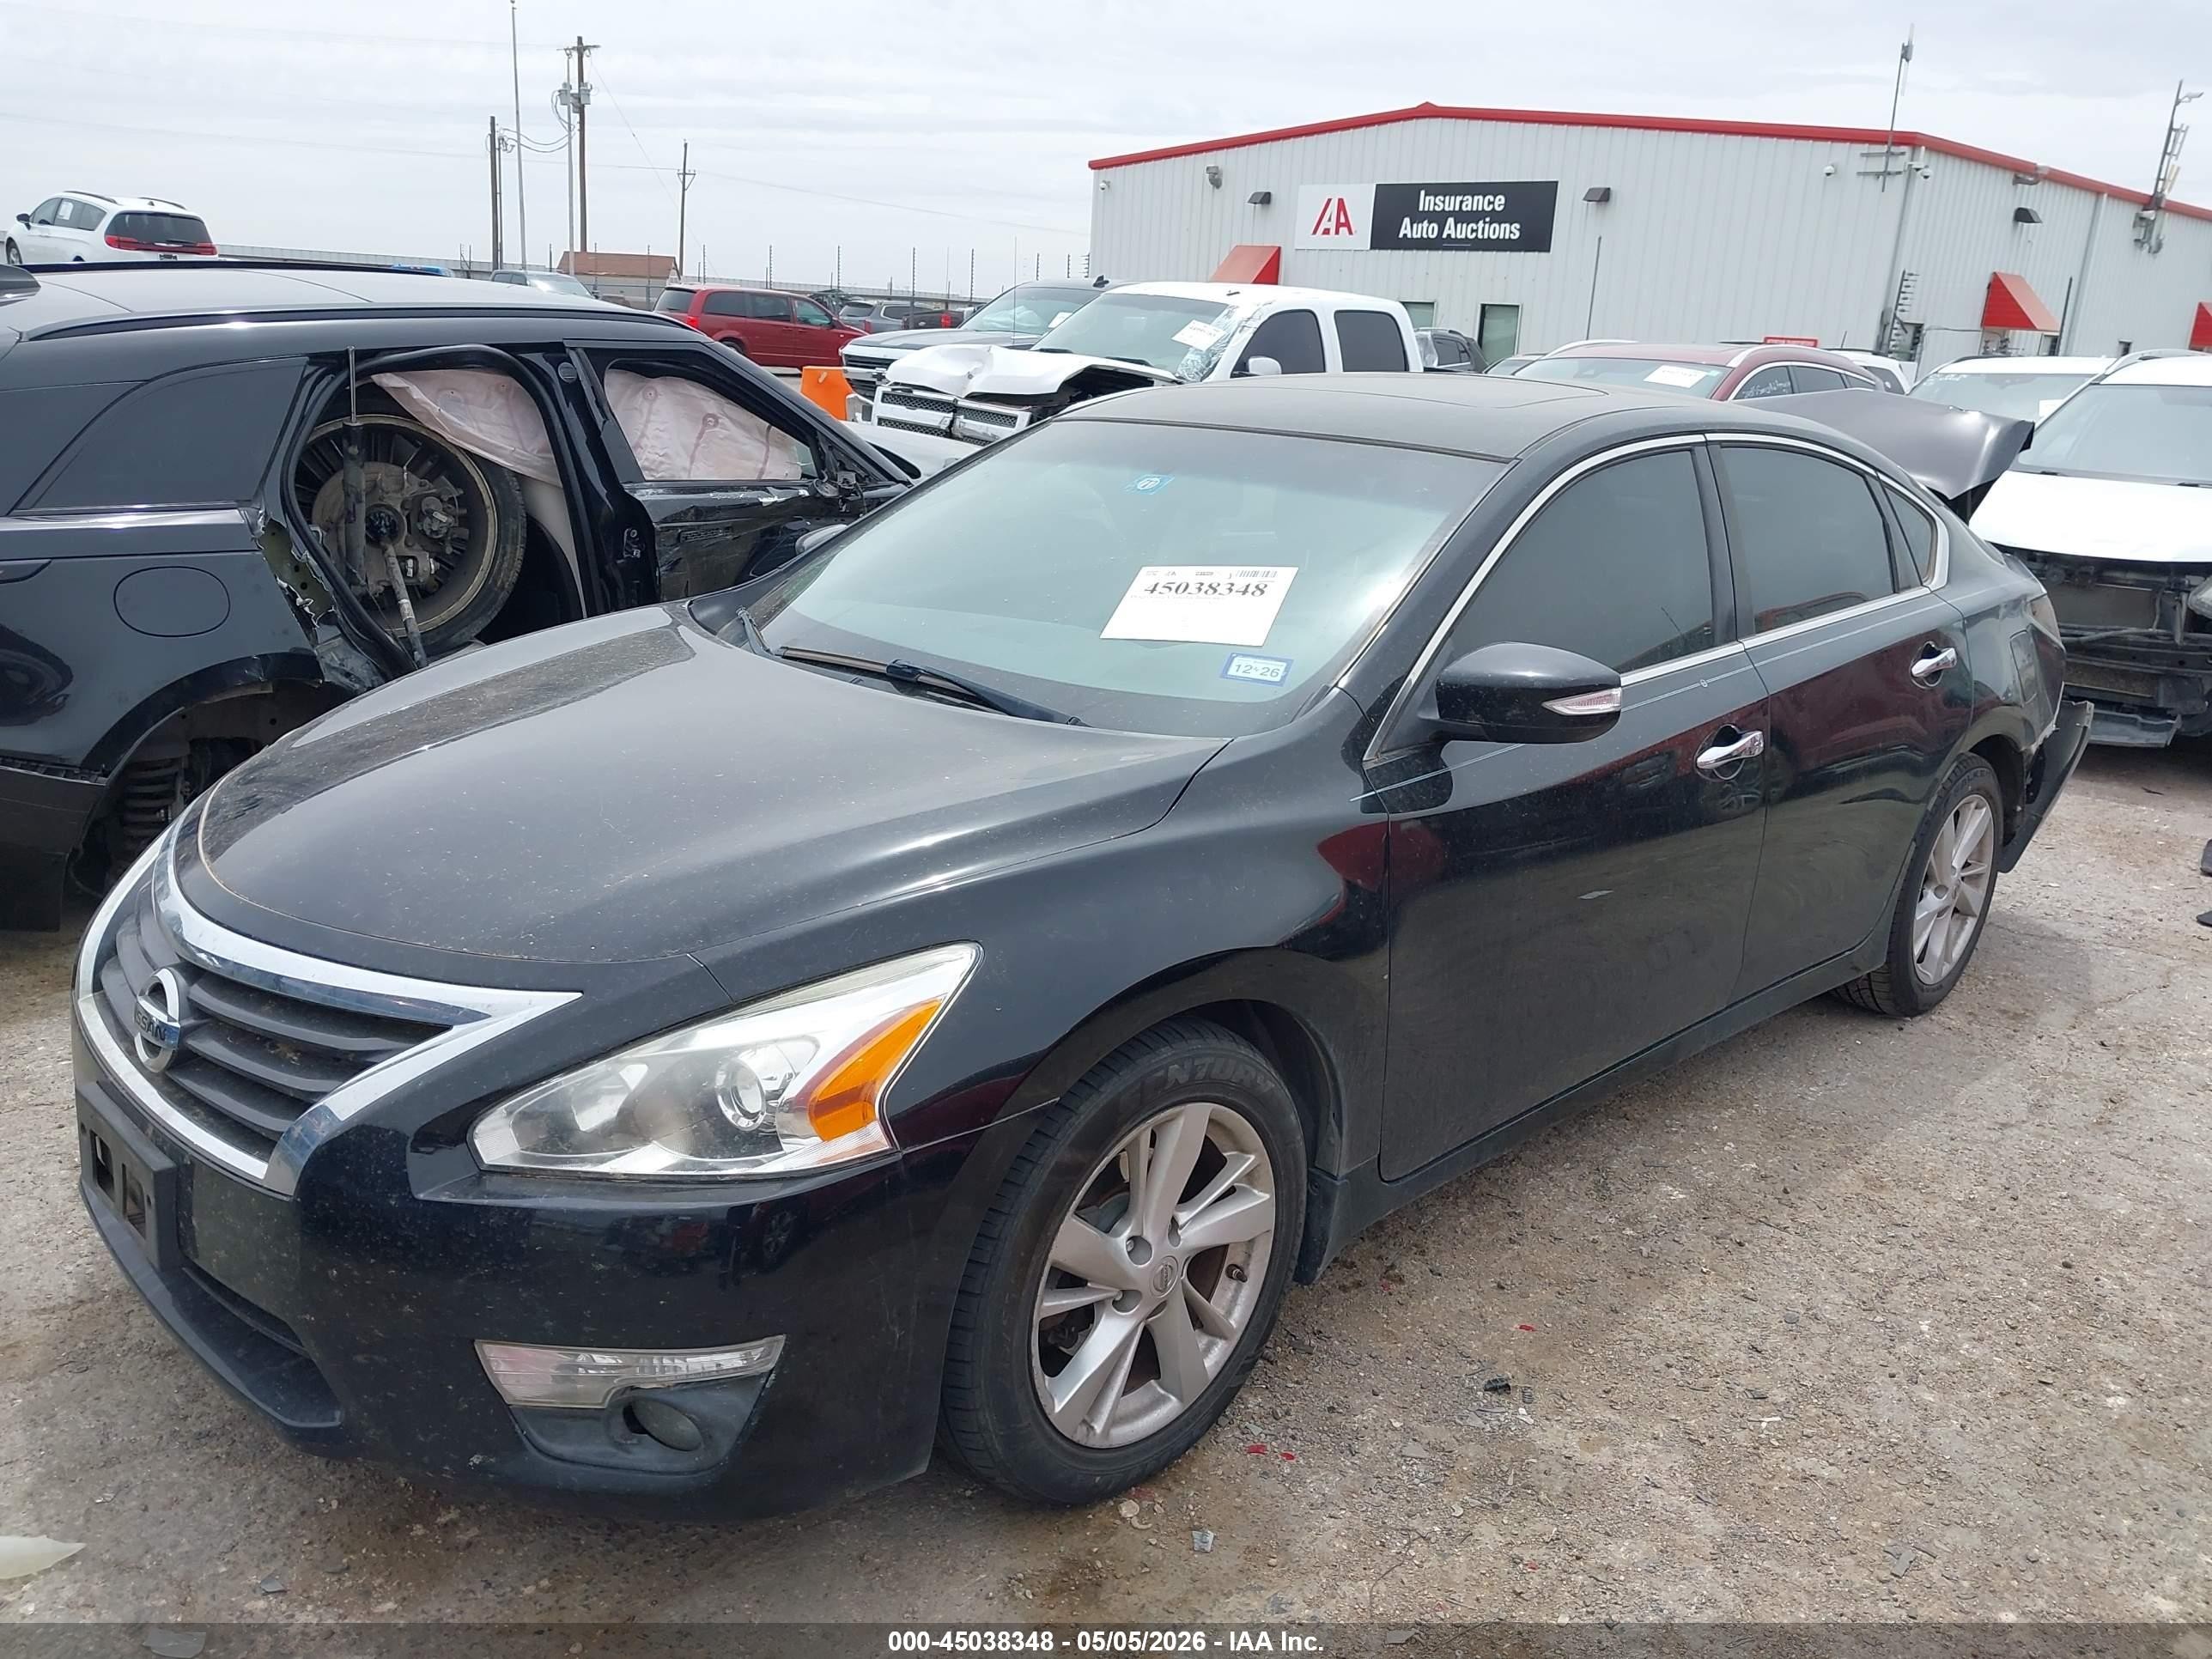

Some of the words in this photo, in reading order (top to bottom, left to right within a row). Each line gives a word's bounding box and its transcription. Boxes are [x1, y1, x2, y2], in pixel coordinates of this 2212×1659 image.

[1418, 189, 1506, 212] Insurance
[1398, 216, 1439, 240] Auto
[1442, 216, 1522, 240] Auctions
[1144, 581, 1268, 597] 45038348
[135, 1011, 167, 1041] SSAN
